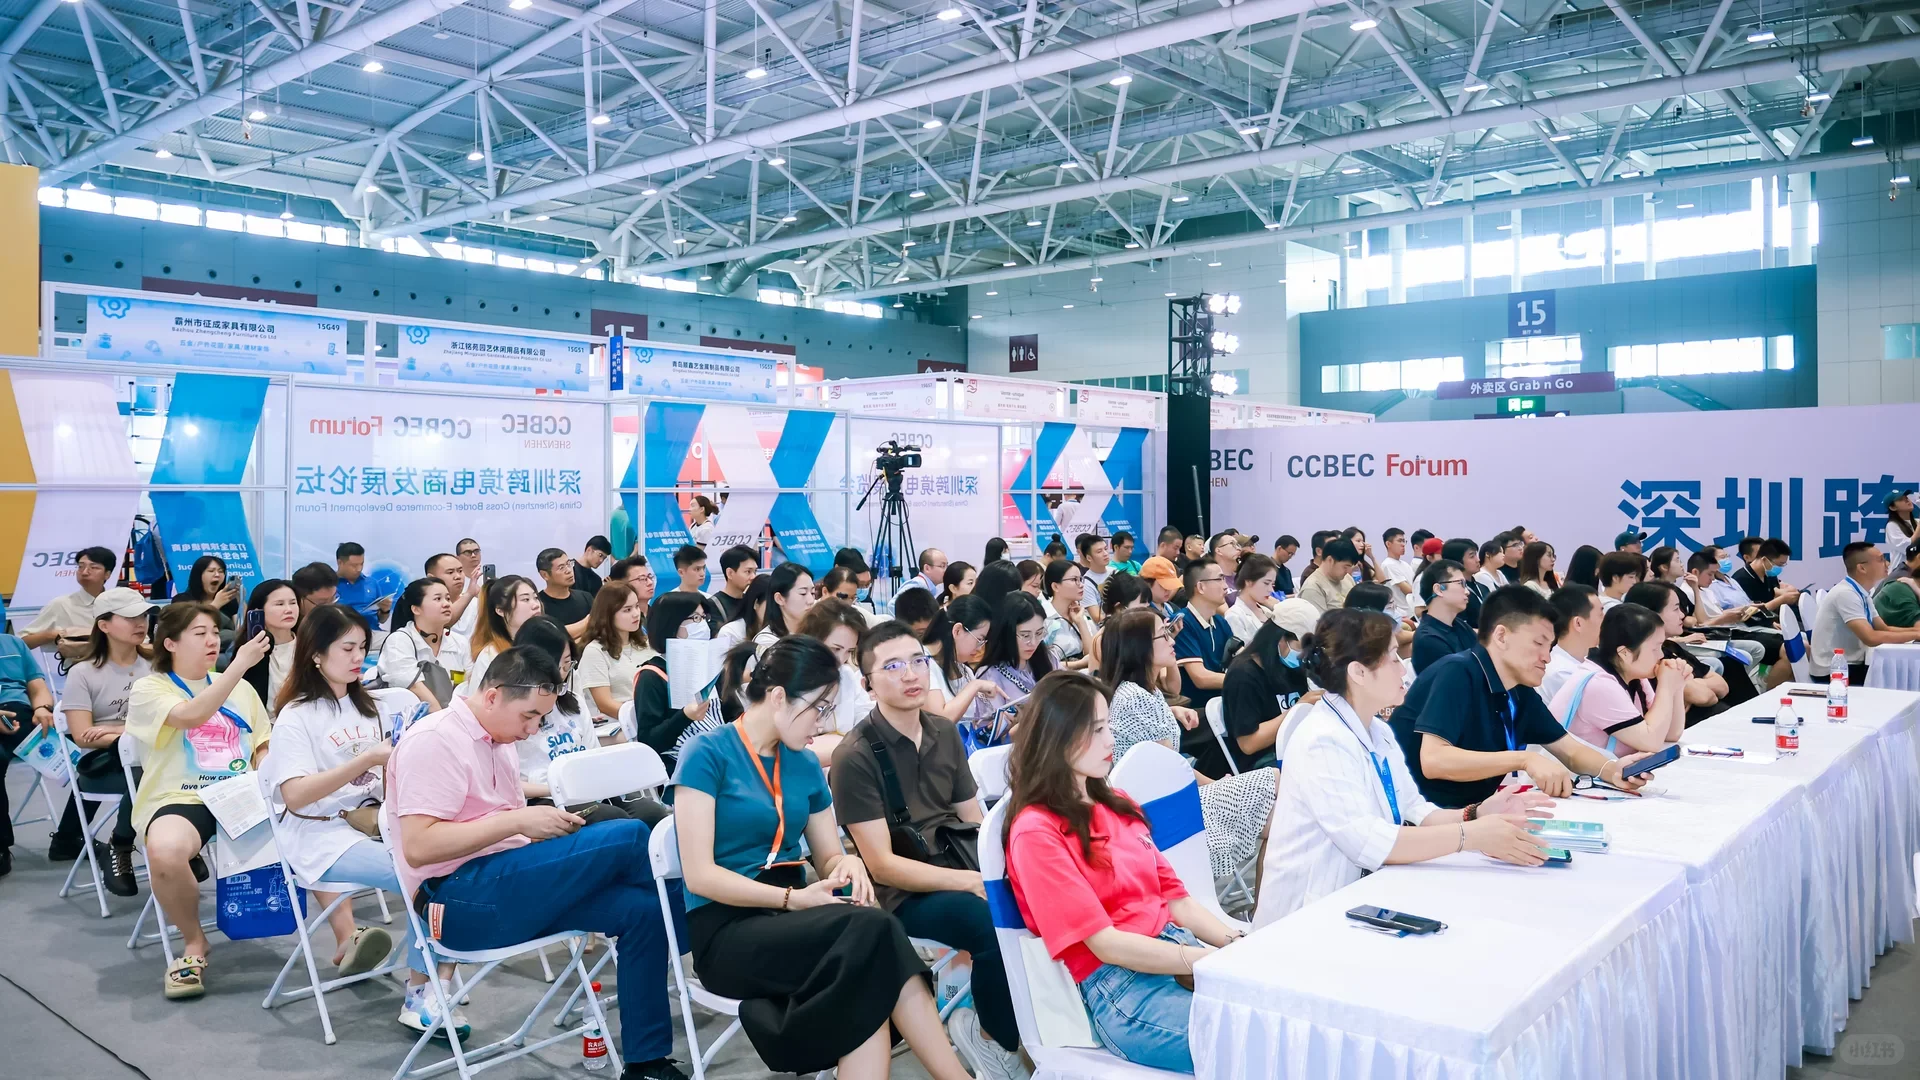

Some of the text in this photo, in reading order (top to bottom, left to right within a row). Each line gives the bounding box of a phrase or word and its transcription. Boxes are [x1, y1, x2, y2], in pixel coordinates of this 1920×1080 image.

[1517, 300, 1547, 327] 15
[174, 316, 275, 334] 霸州市征成家具有限公司
[317, 323, 340, 331] 15G49
[1470, 378, 1573, 395] 外卖区 Grab n Go
[1210, 448, 1254, 471] BEC
[1287, 453, 1468, 478] CCBEC Forum
[1617, 474, 1920, 562] 深圳跨
[329, 725, 380, 747] ELLE
